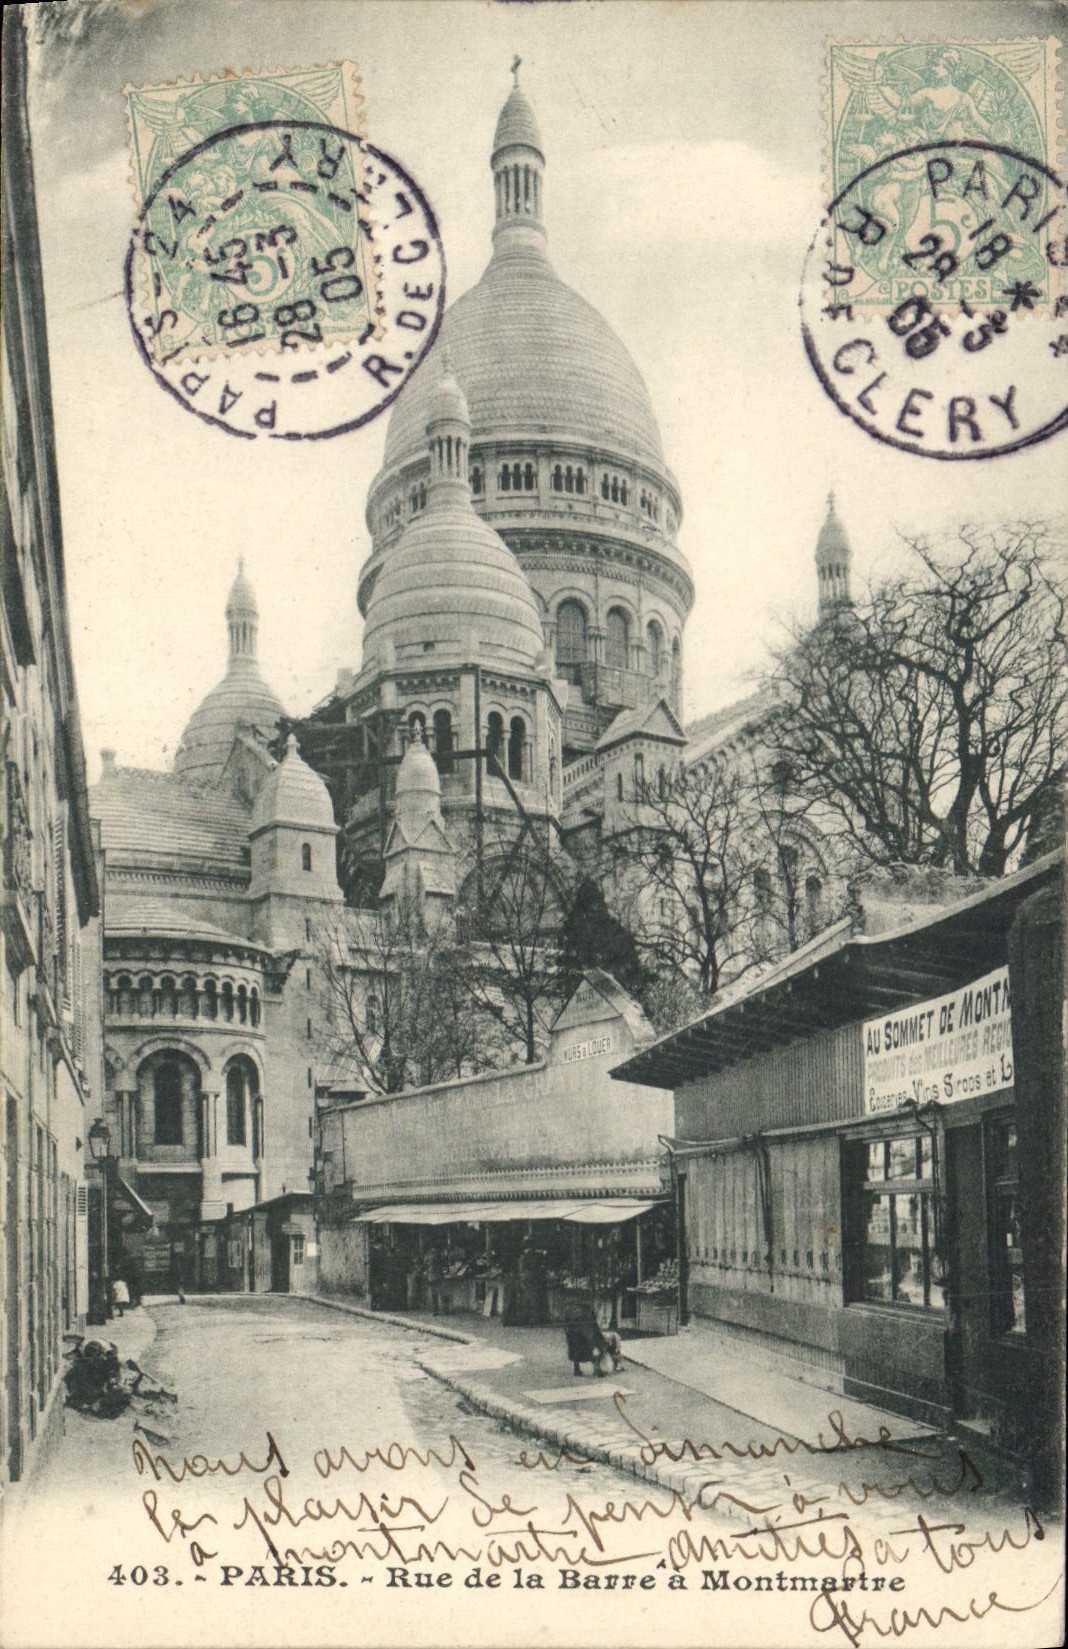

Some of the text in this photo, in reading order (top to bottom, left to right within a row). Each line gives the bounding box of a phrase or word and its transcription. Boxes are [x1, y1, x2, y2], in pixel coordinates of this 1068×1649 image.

[902, 233, 959, 283] 28
[968, 218, 1012, 271] 18
[203, 237, 266, 347] 16 45
[311, 246, 364, 303] 05
[897, 278, 986, 302] POSTES
[273, 299, 323, 350] 28
[886, 295, 951, 359] 05
[833, 338, 1019, 442] CLERY
[866, 1027, 880, 1057] AU
[884, 1010, 935, 1050] SOMMET
[939, 1002, 955, 1035] DE
[943, 1072, 981, 1098] Sirops
[986, 1064, 997, 1086] et
